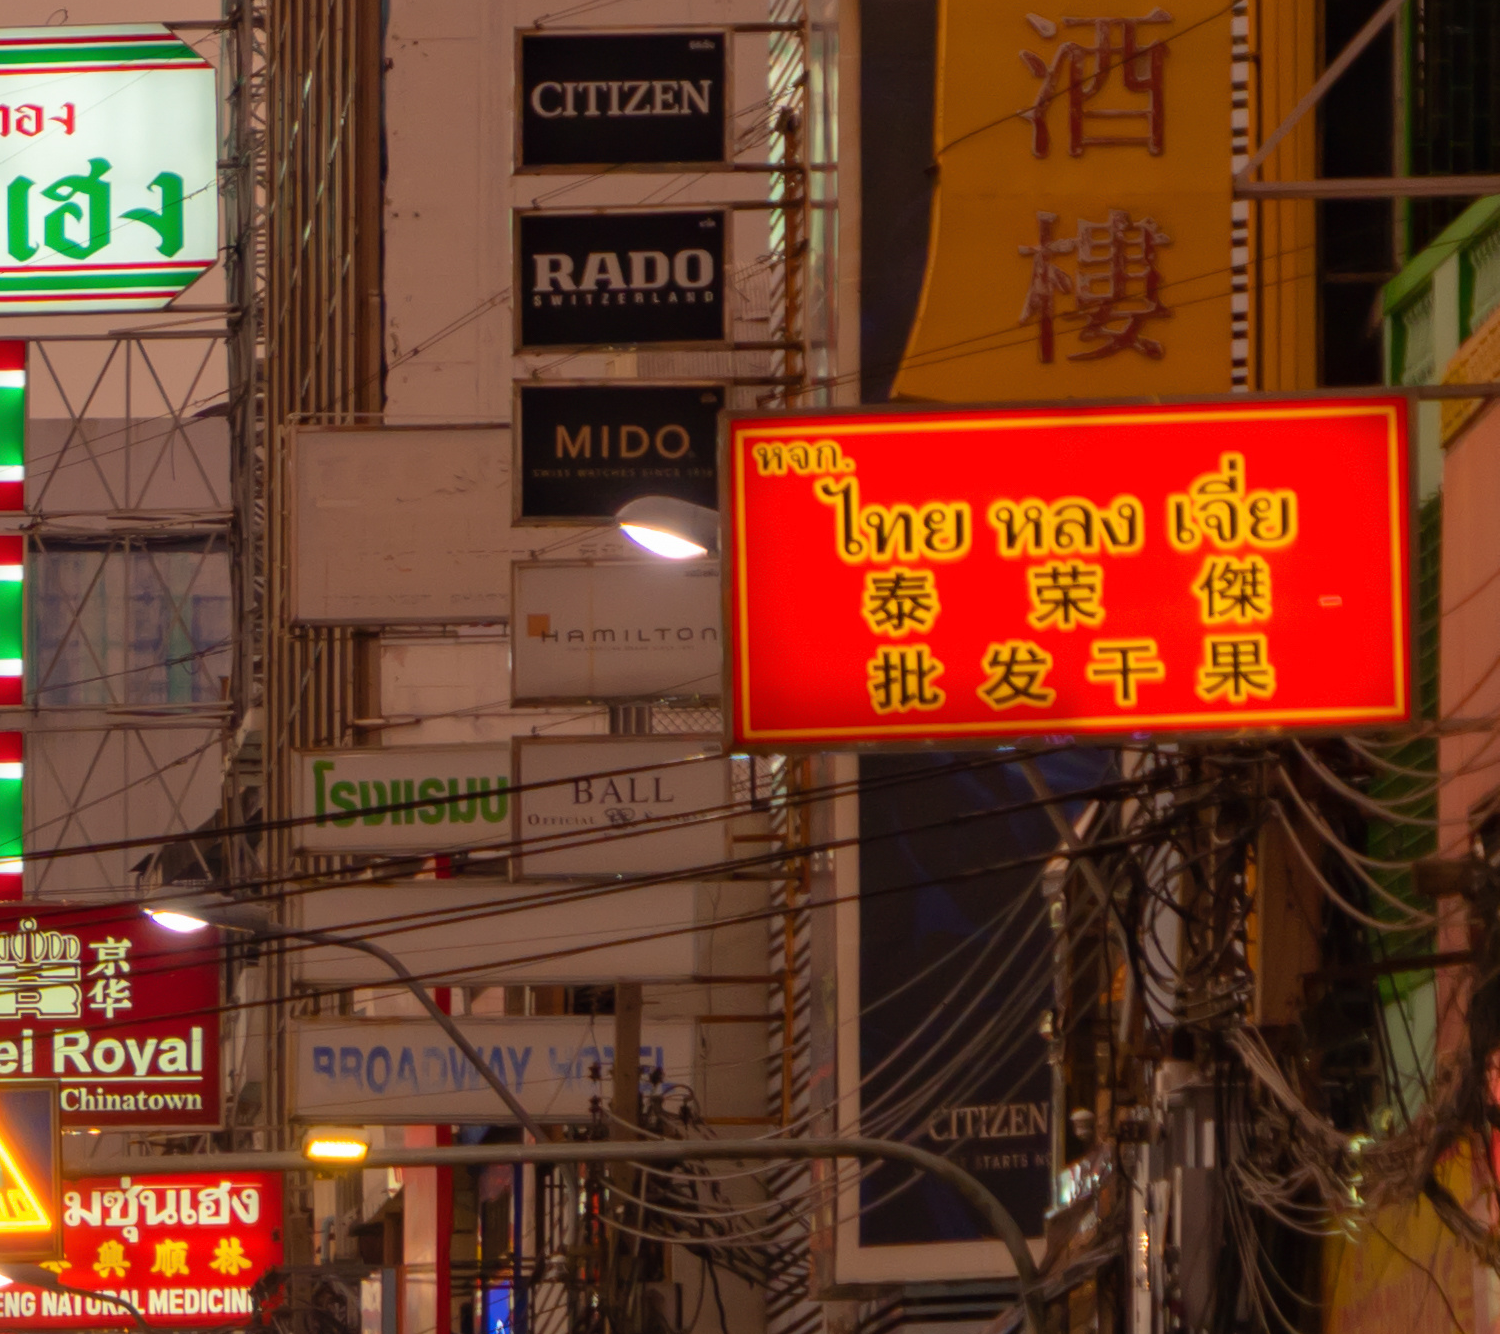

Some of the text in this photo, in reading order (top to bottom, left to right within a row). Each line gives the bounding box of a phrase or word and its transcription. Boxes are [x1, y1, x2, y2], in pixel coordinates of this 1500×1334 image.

[530, 79, 713, 119] CITIZEN
[531, 249, 715, 292] RADO
[532, 290, 714, 305] SWITZERLAND
[554, 425, 688, 460] MIDO
[753, 436, 856, 475] หจก.
[820, 453, 1298, 561] ไทย หลง เจี่ย
[540, 627, 719, 643] HAMILTON
[869, 636, 1278, 713] 批发干果
[572, 776, 675, 805] BALL
[84, 936, 133, 1019] 京华
[53, 1026, 203, 1077] Royal
[313, 1045, 528, 1094] BROADWAY
[60, 1087, 203, 1112] Chinatown
[929, 1102, 1049, 1142] CITIZEN
